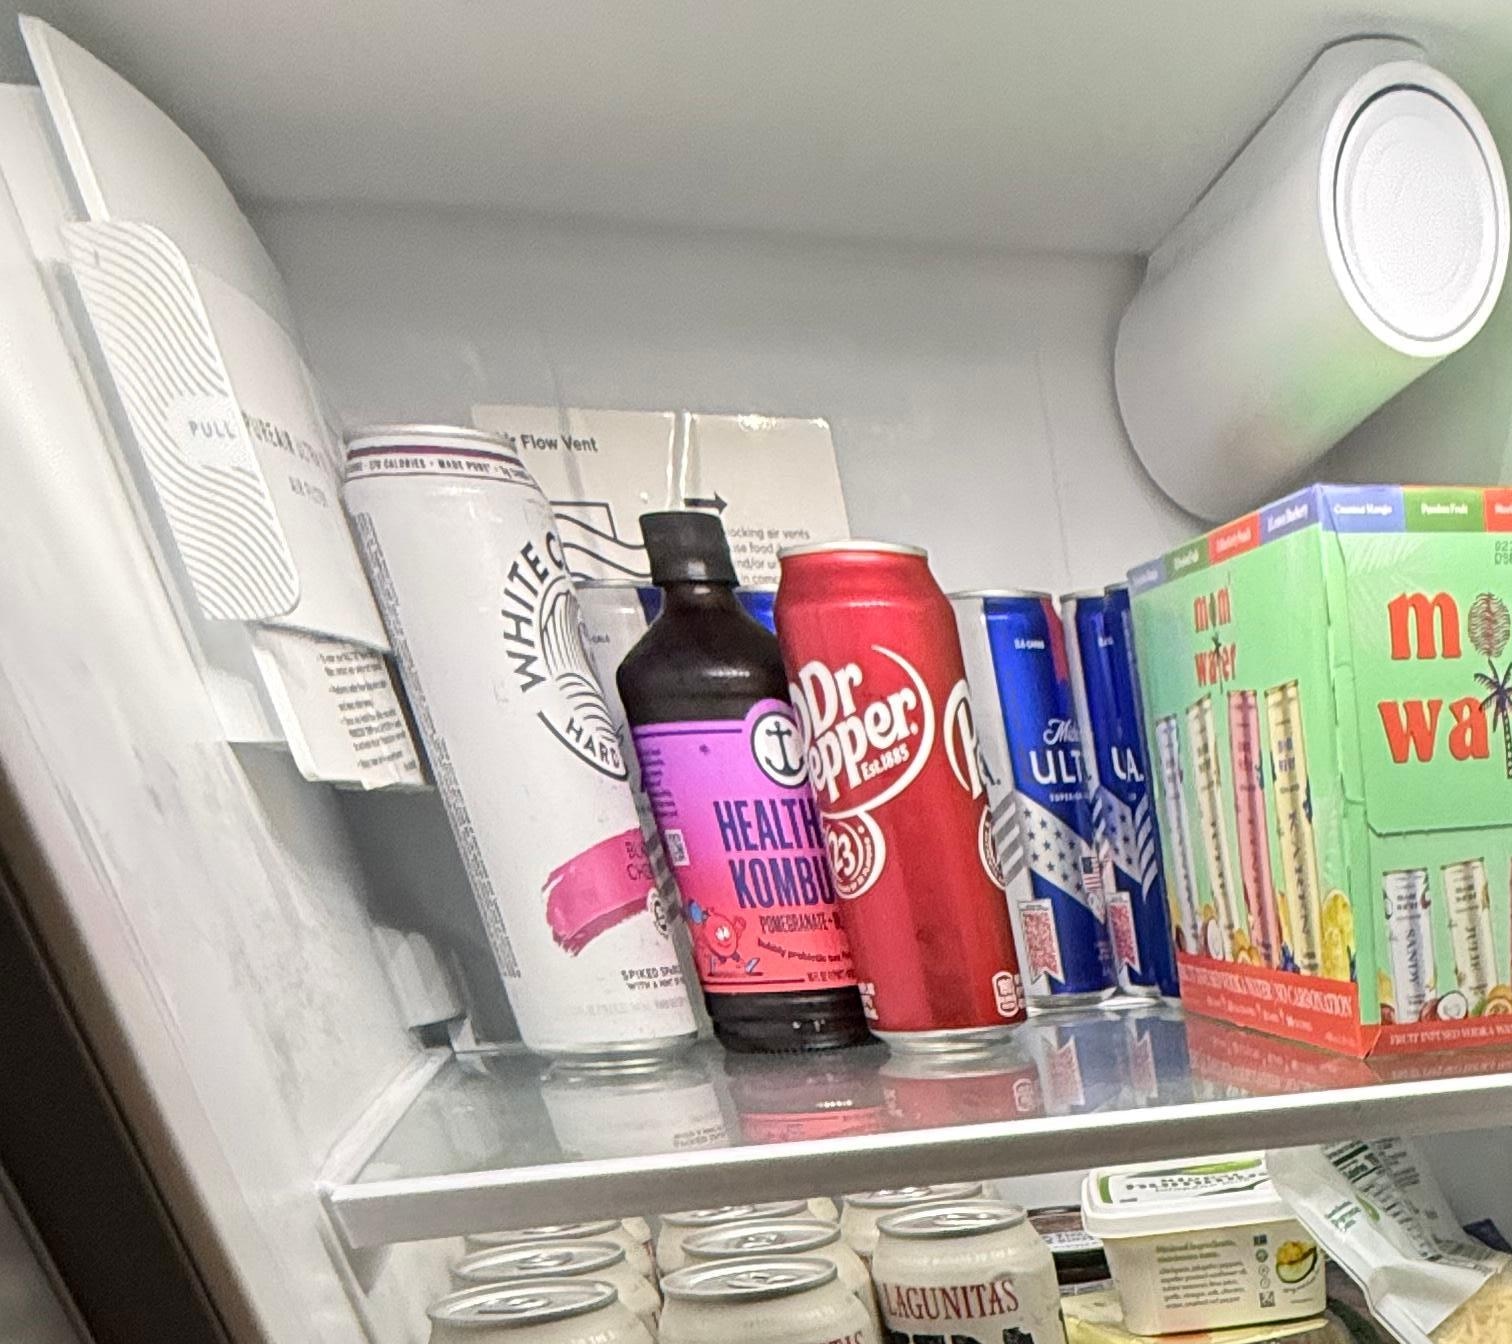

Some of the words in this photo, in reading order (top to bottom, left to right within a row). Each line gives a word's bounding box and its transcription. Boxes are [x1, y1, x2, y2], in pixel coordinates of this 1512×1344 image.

[188, 420, 236, 438] PULL
[522, 434, 557, 451] Flow
[561, 434, 599, 452] Vent
[783, 528, 810, 540] vents
[501, 541, 549, 693] WHITE
[1194, 587, 1231, 633] mom
[1194, 642, 1236, 688] water
[799, 660, 863, 733] Dr
[621, 967, 659, 981] SPIKED
[883, 1278, 1019, 1320] LAGUNITAS
